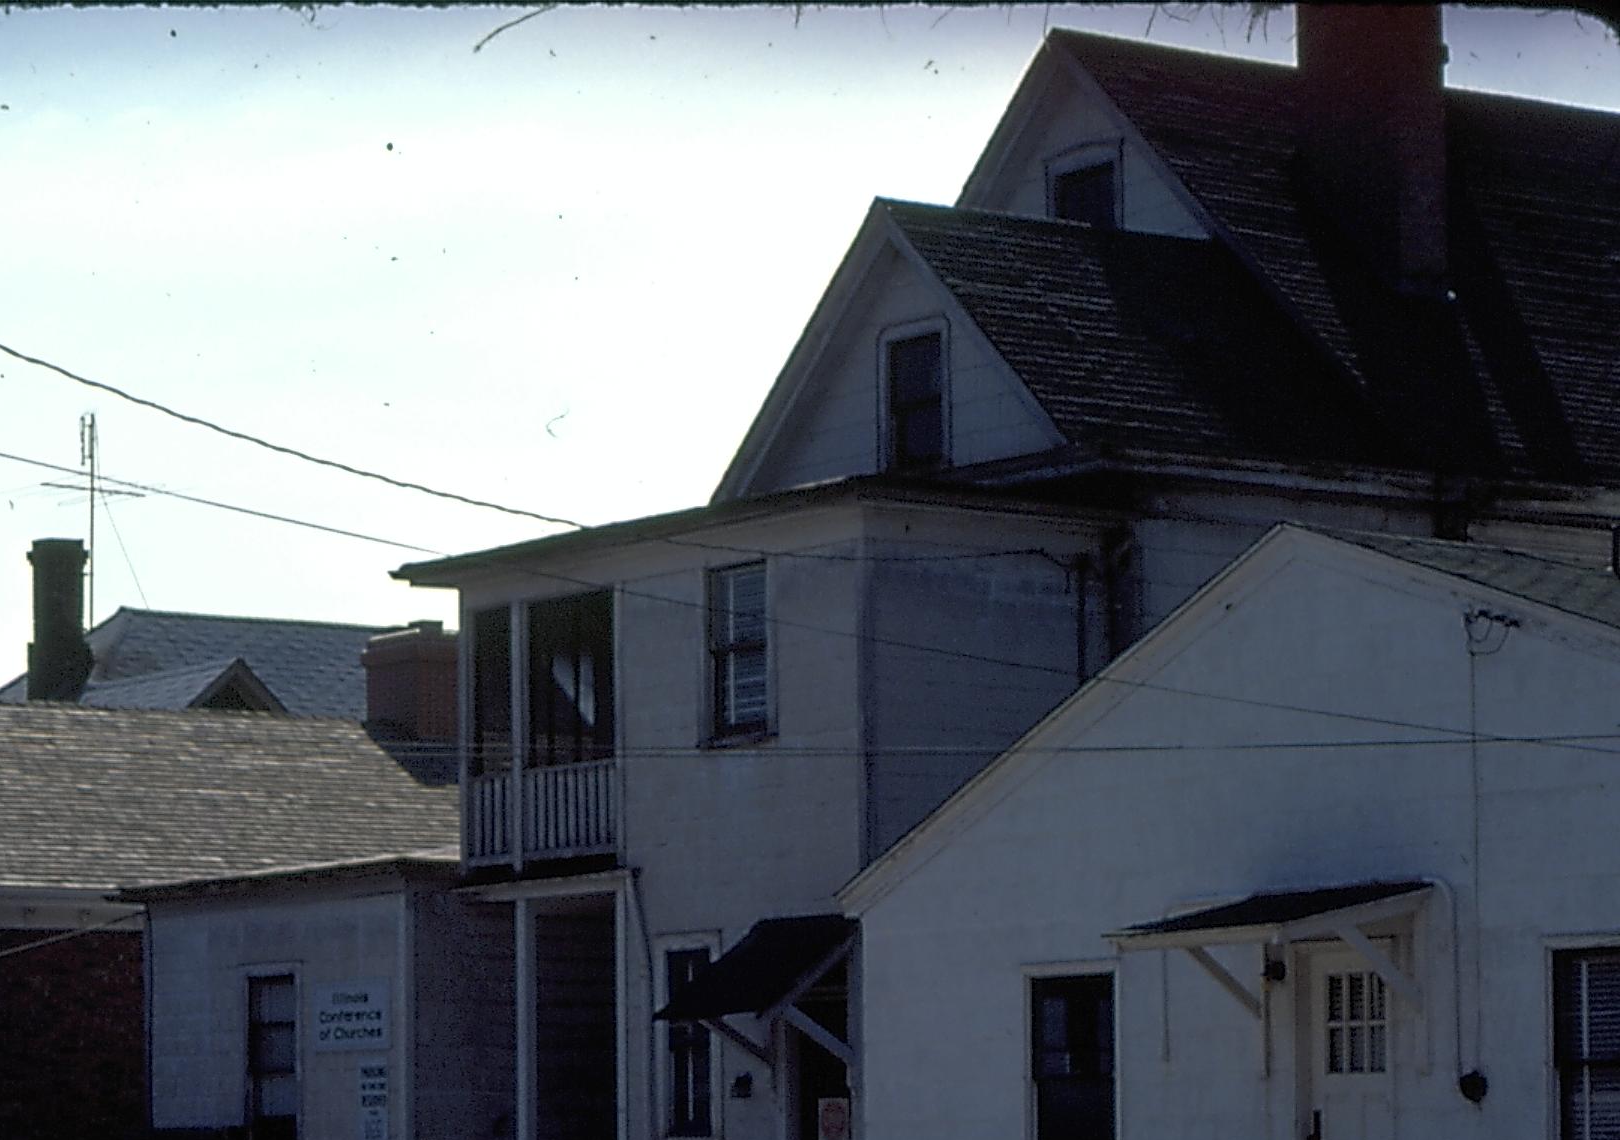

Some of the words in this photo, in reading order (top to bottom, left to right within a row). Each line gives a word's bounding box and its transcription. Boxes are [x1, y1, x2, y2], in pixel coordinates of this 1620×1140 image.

[318, 1010, 383, 1024] Conference
[318, 1028, 331, 1041] of
[333, 1026, 383, 1041] Churches
